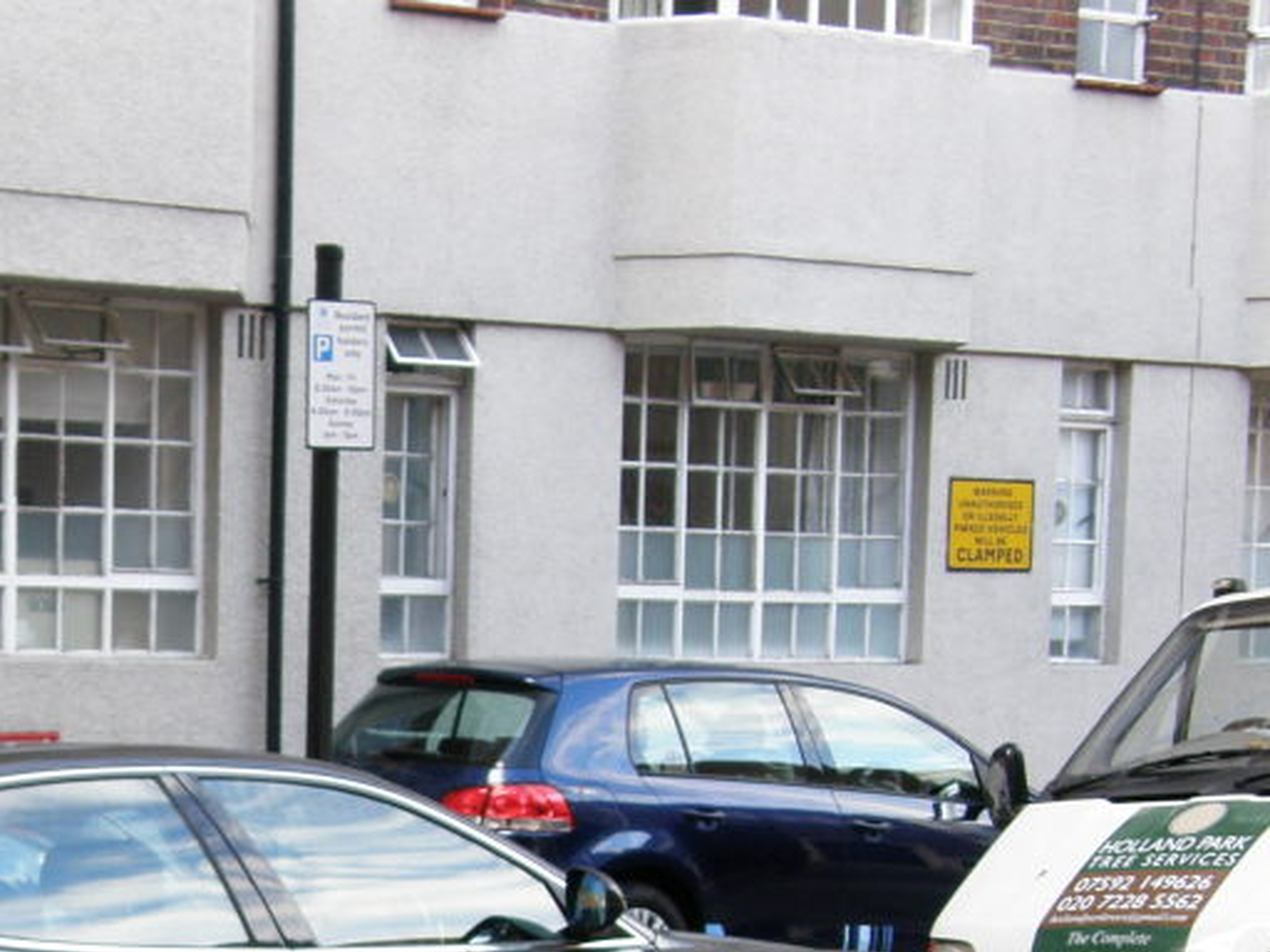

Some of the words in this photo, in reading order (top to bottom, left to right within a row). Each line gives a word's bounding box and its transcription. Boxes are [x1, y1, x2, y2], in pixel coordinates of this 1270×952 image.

[317, 337, 330, 359] P
[956, 547, 1023, 564] CLAMPED
[1099, 835, 1196, 855] HOLLAND
[1196, 834, 1253, 851] PARK
[1087, 854, 1140, 870] TREE
[1140, 852, 1241, 868] SERVICES
[1073, 875, 1136, 893] 07592
[1138, 874, 1217, 891] 149626
[1055, 895, 1095, 912] 020
[1096, 894, 1148, 911] 7228
[1148, 893, 1204, 911] 5562
[1066, 930, 1090, 947] The
[1091, 929, 1153, 948] Complete
